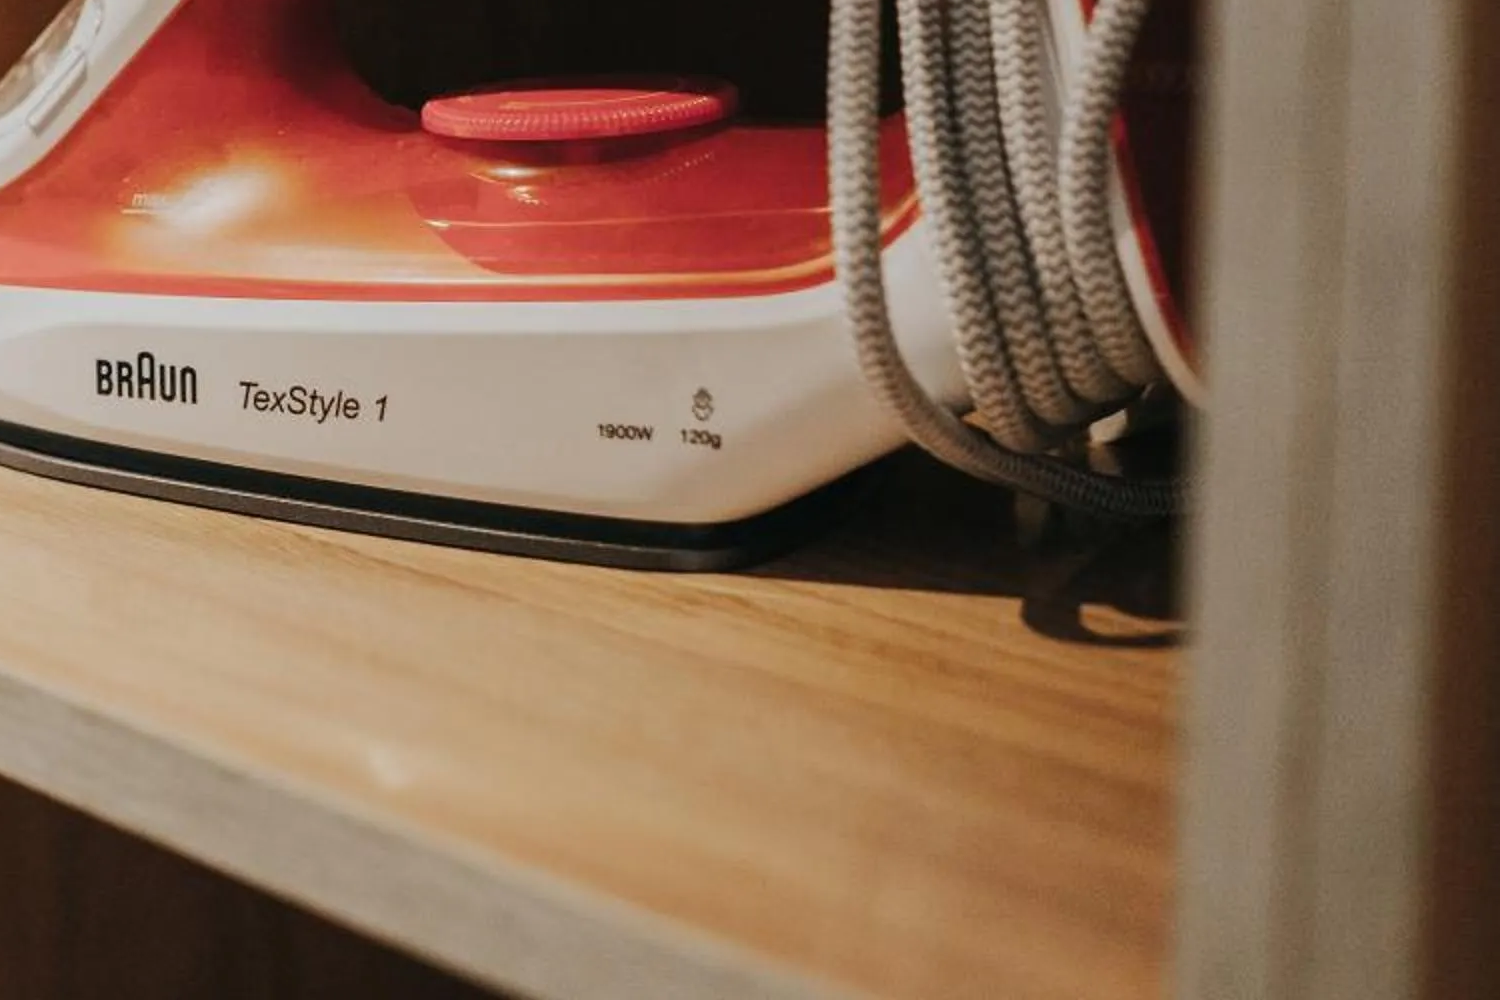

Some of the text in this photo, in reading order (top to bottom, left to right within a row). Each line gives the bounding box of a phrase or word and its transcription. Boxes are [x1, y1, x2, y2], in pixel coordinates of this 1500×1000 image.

[239, 381, 388, 424] TexStyle 1
[597, 423, 653, 441] 1900W
[681, 428, 721, 450] 120g
